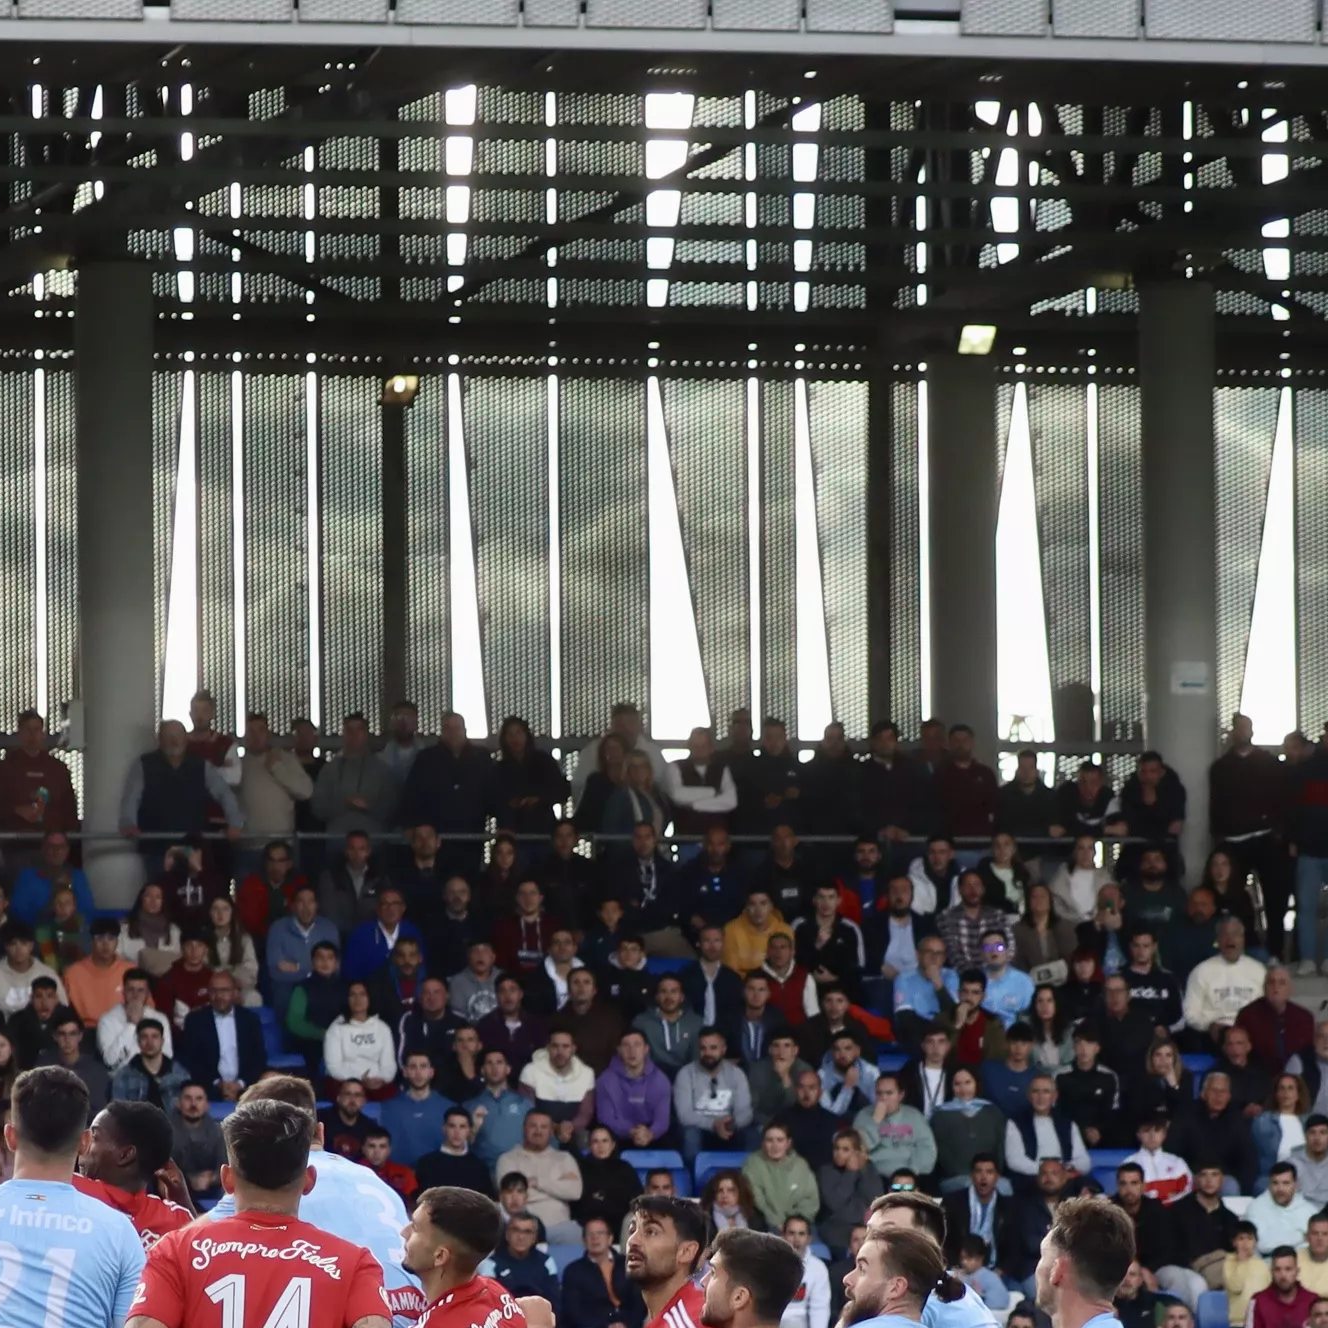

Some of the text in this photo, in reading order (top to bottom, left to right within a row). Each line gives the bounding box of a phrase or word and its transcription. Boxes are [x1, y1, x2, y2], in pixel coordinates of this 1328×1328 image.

[9, 1204, 93, 1235] Infrico
[191, 1238, 279, 1271] Siempre
[278, 1239, 342, 1280] Fieles
